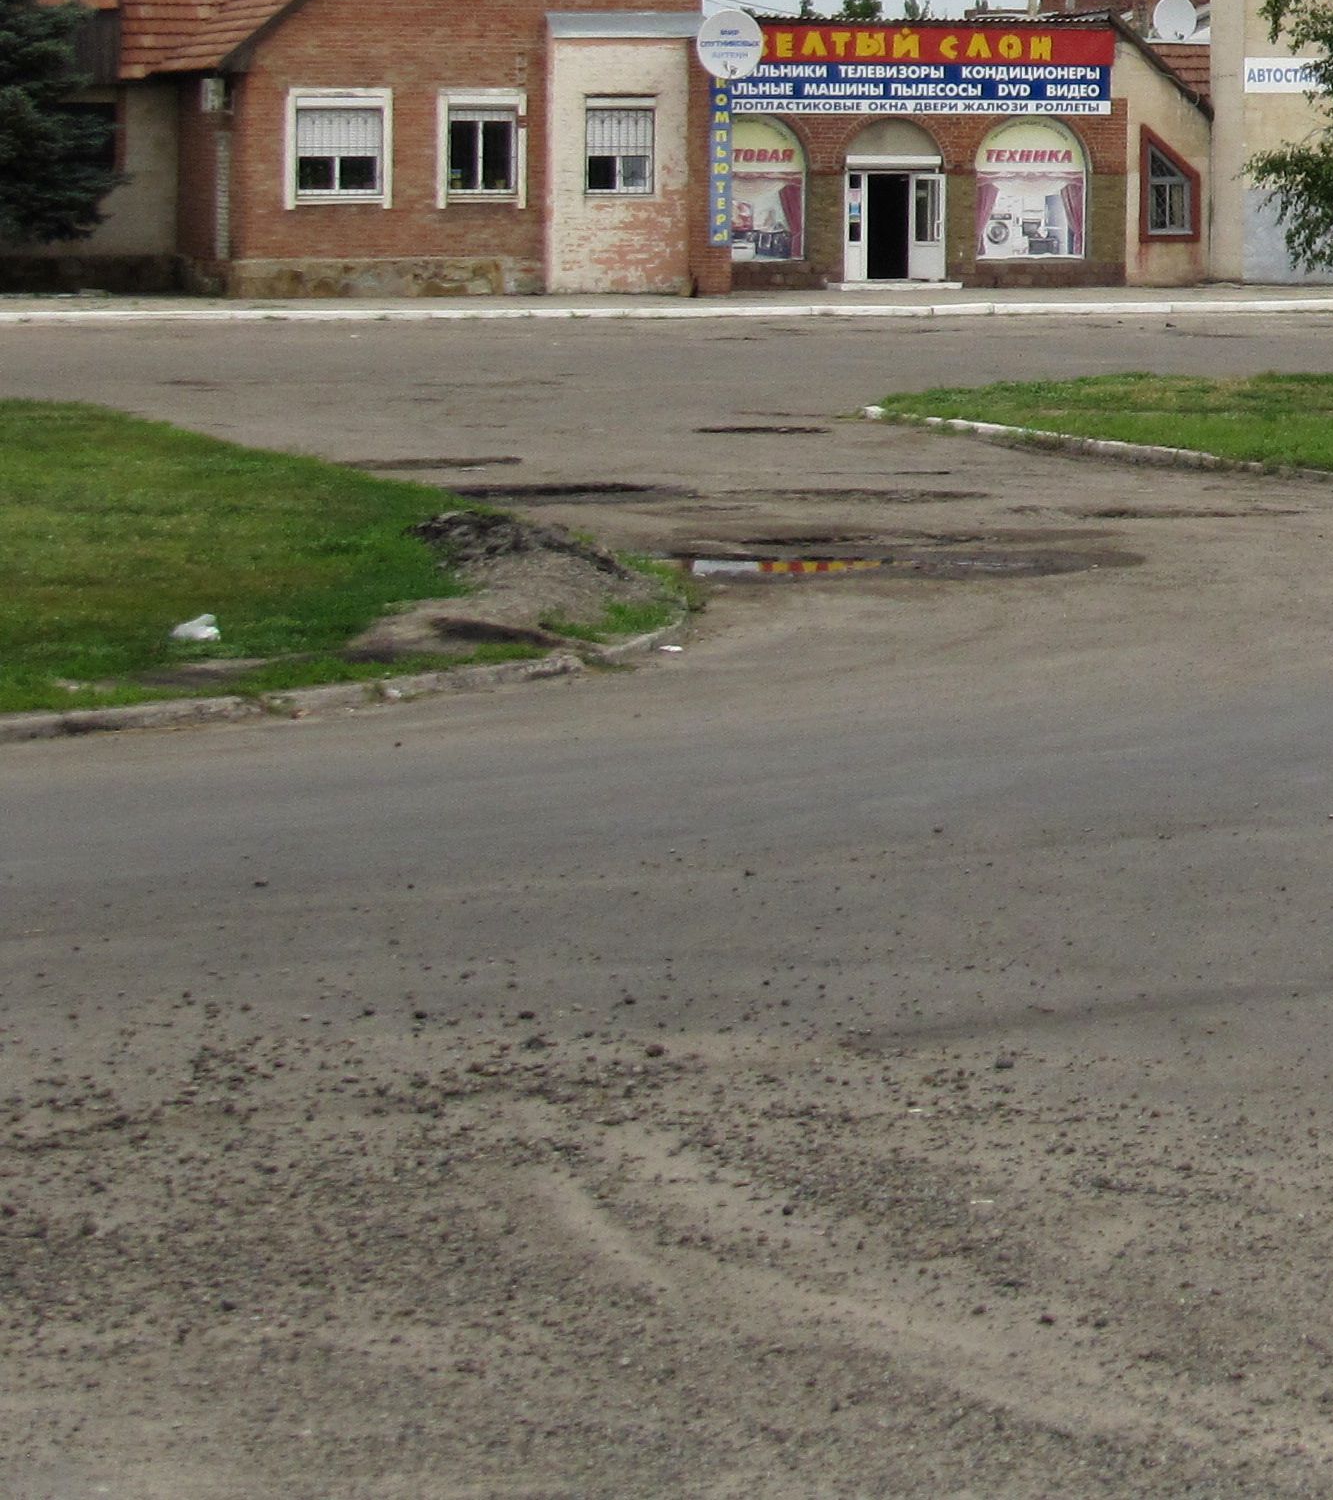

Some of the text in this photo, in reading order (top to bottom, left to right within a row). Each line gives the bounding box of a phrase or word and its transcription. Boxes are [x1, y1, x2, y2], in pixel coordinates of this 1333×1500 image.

[939, 33, 1052, 60] СЛОН
[838, 65, 945, 79] ТЕЛЕВИЗОРЫ
[961, 66, 1100, 81] КОНДИЦИОНЕРЫ
[1247, 68, 1326, 83] АВТОСТАН
[803, 83, 884, 96] МАШИНЫ
[890, 83, 982, 97] ПЫЛЕСОСЫ
[998, 84, 1031, 97] DVD
[1046, 84, 1100, 98] ВИДЕО
[868, 102, 908, 111] ОКНА
[913, 102, 958, 113] ДВЕРИ
[962, 102, 1029, 113] ЖАЛЮЗИ
[1036, 103, 1100, 113] РОЛЛЕТЫ
[713, 78, 729, 241] КОМПЬЮТЕРЫ
[986, 149, 1073, 163] ТЕХНИКА
